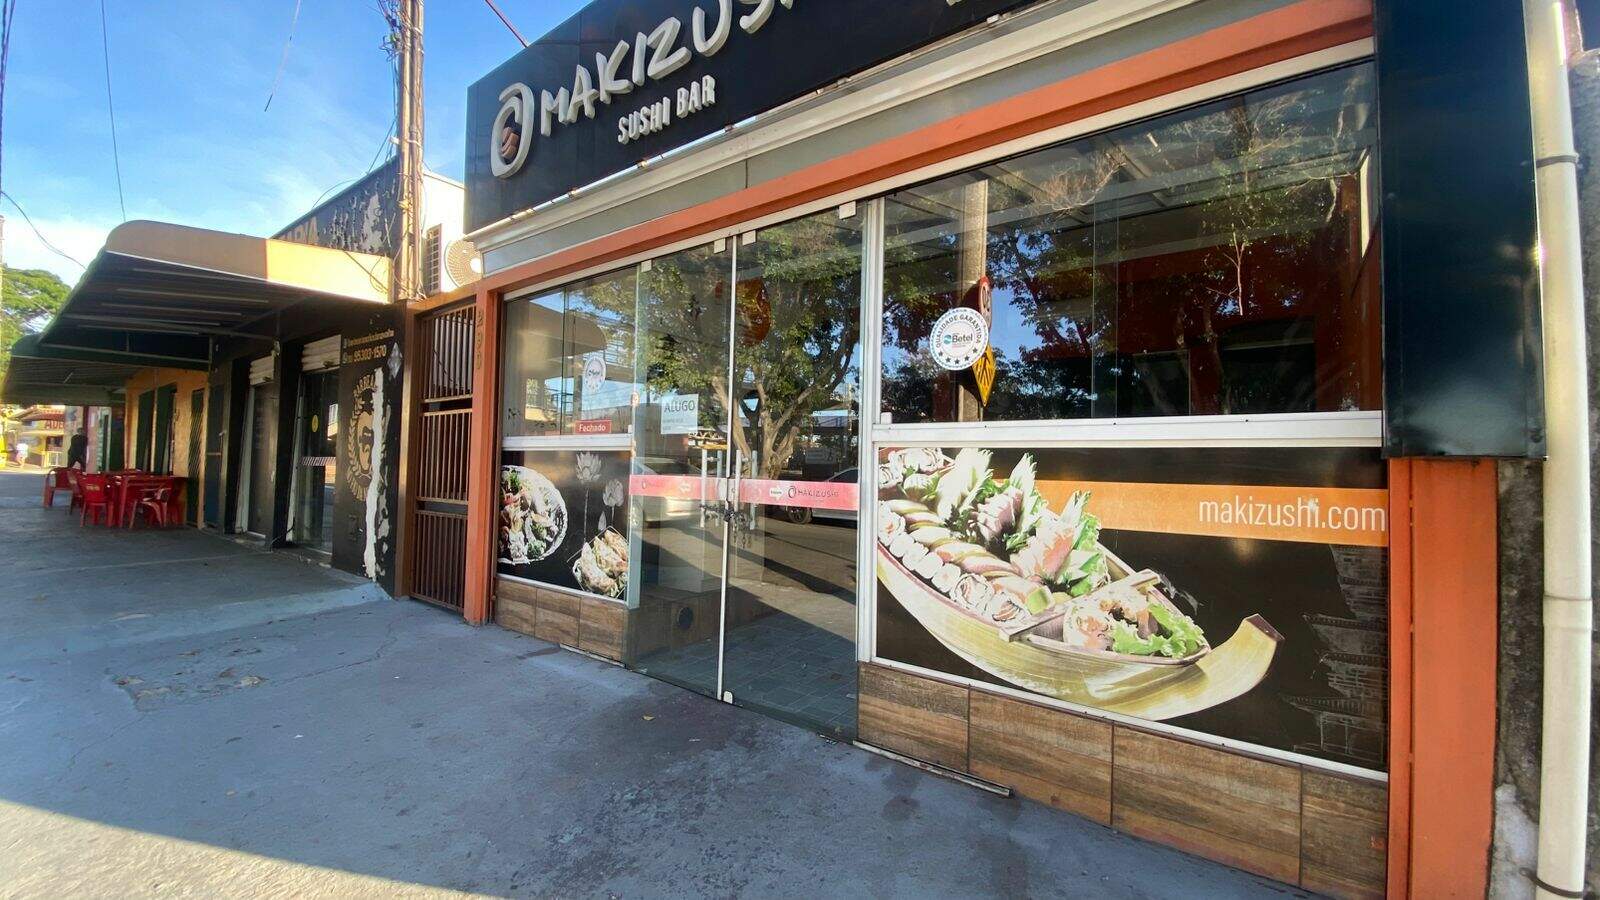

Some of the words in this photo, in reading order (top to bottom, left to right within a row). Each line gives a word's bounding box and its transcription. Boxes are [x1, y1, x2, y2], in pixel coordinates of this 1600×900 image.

[540, 0, 792, 137] MAKIZUS
[618, 96, 670, 145] SUSHI
[676, 74, 716, 119] BAR
[952, 333, 973, 343] Betel
[663, 400, 695, 413] ALUGO
[578, 422, 606, 433] Fechado
[1198, 495, 1386, 532] makizushi.com
